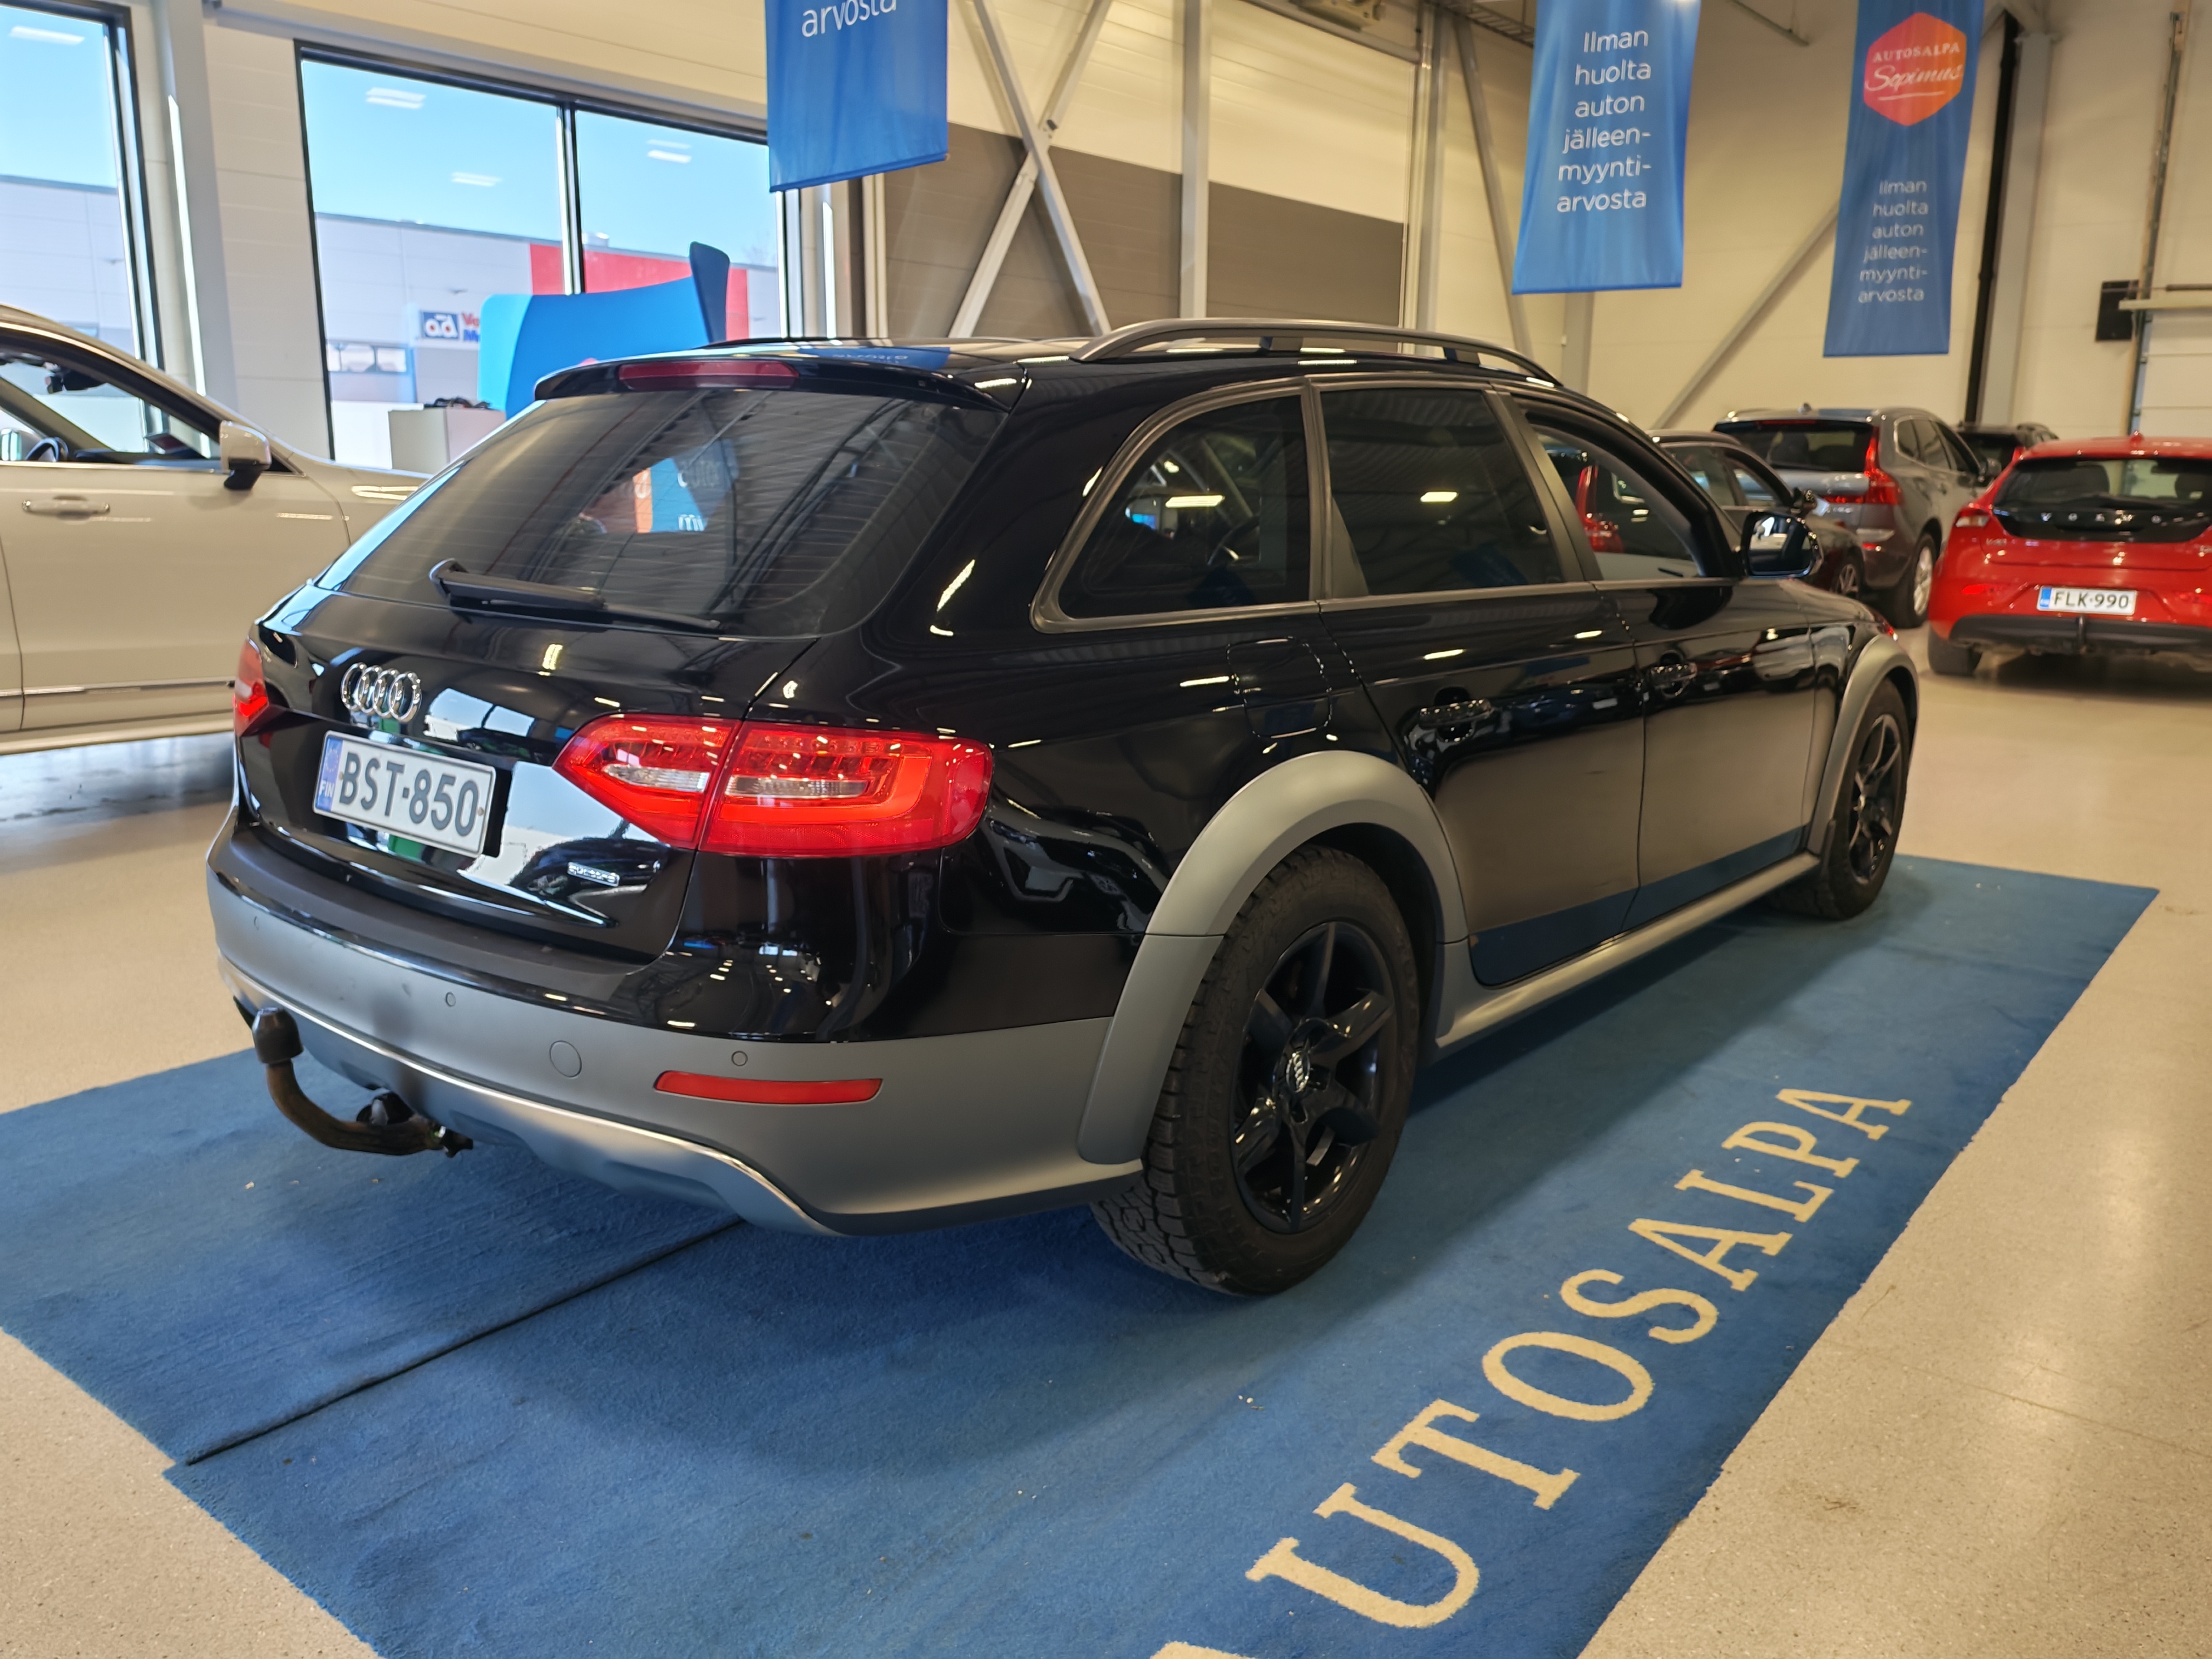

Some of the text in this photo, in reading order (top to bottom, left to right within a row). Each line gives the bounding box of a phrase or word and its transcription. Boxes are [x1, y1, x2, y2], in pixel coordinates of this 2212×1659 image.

[1583, 29, 1649, 53] Ilman
[1872, 42, 1960, 63] AUTOSALPA
[1575, 59, 1651, 85] huolta
[1575, 94, 1645, 118] auton
[1562, 126, 1651, 154] jälleen-
[1558, 154, 1652, 184] myynti-
[1879, 179, 1927, 195] Ilman
[1556, 187, 1647, 212] arvosta
[1873, 199, 1928, 217] huolta
[1872, 222, 1924, 239] auton
[1863, 244, 1927, 264] jälleen-
[1859, 265, 1927, 284] myynti-
[1858, 286, 1925, 304] arvosta
[320, 779, 335, 798] FIN
[339, 751, 479, 837] BST-850
[1149, 1088, 1912, 1659] UTOSALPA
